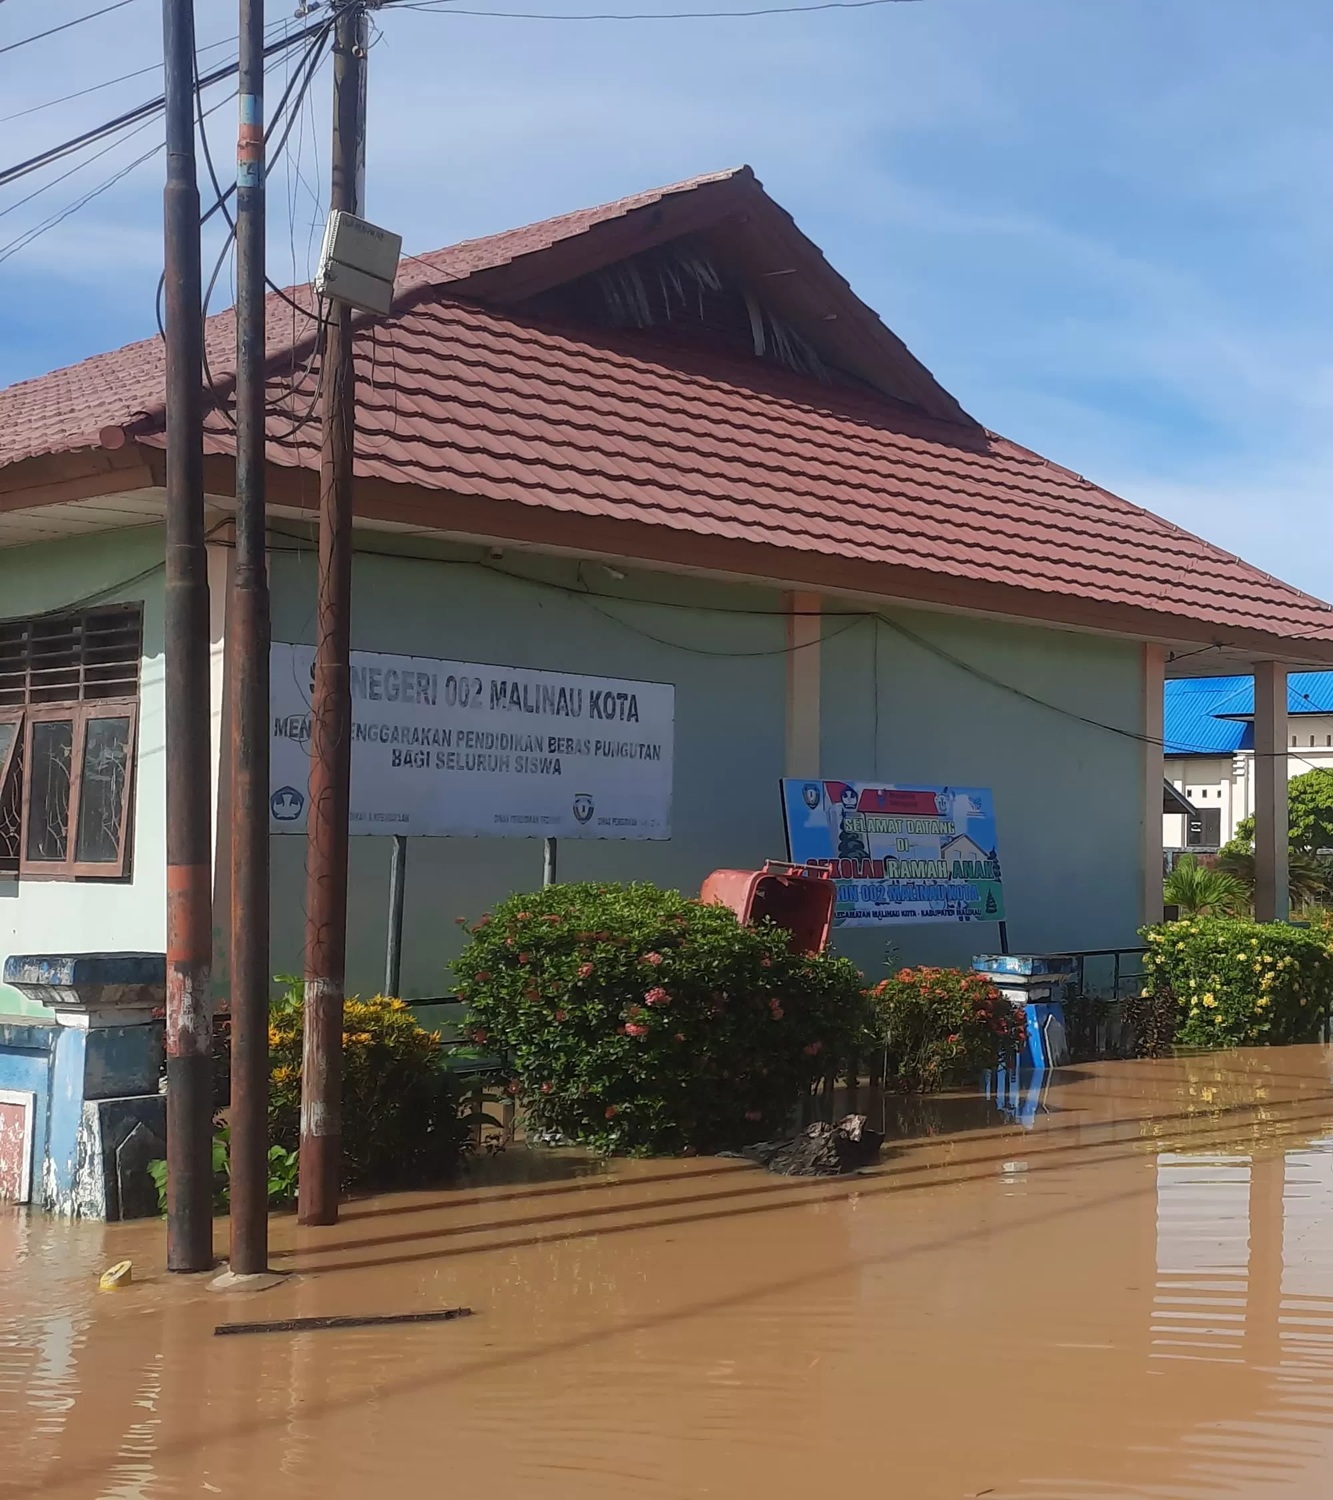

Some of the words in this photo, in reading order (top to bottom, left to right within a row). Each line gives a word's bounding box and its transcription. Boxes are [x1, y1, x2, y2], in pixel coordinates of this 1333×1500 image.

[351, 665, 437, 706] NEGERI
[445, 675, 483, 709] 002
[490, 680, 582, 717] MALINAU
[589, 690, 639, 722] KOTA
[456, 730, 544, 753] PENDIDIKAN
[548, 736, 590, 756] BEBAS
[594, 740, 661, 761] PUNGUTAN
[391, 749, 430, 769] BAGI
[436, 751, 509, 773] SELURUH
[515, 755, 562, 775] SISWA
[844, 817, 904, 834] SELAMAT
[907, 819, 956, 835] DATANG
[896, 838, 910, 852] DI
[888, 860, 948, 879] RAMAH
[952, 860, 995, 879] ANAK
[887, 884, 946, 901] MALINAU
[947, 884, 979, 901] KOTA
